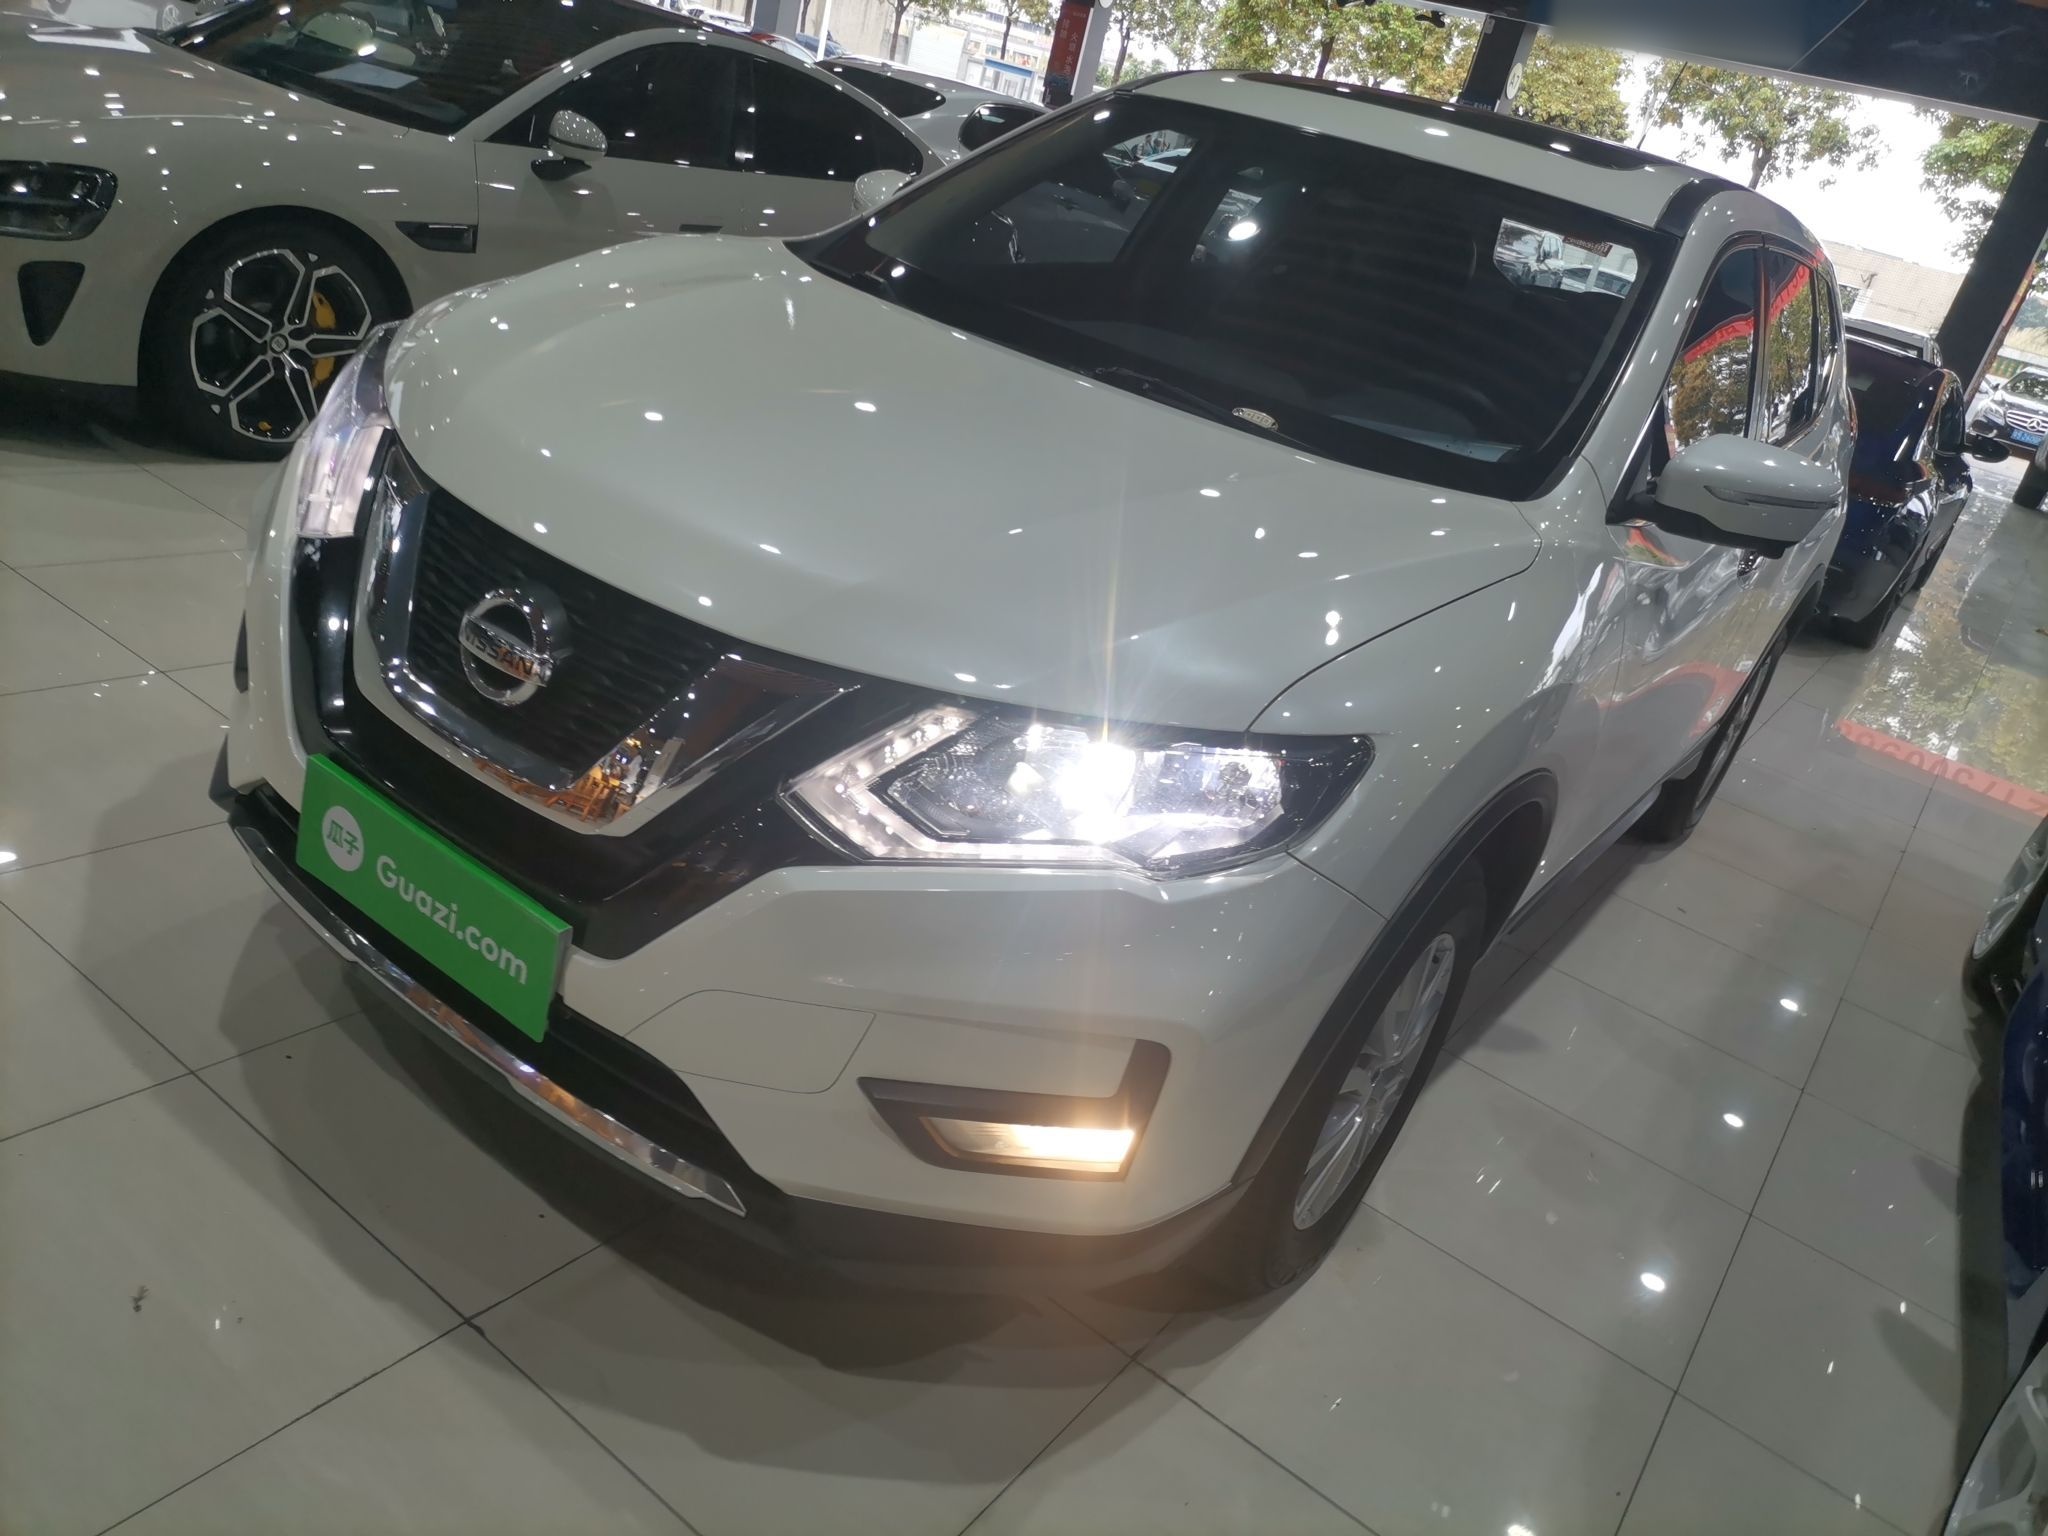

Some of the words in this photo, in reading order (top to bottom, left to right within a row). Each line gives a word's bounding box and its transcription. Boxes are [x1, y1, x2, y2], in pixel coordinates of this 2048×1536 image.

[464, 629, 536, 675] NISSAN
[326, 819, 360, 857] 瓜子
[376, 855, 528, 985] Guazi.com
